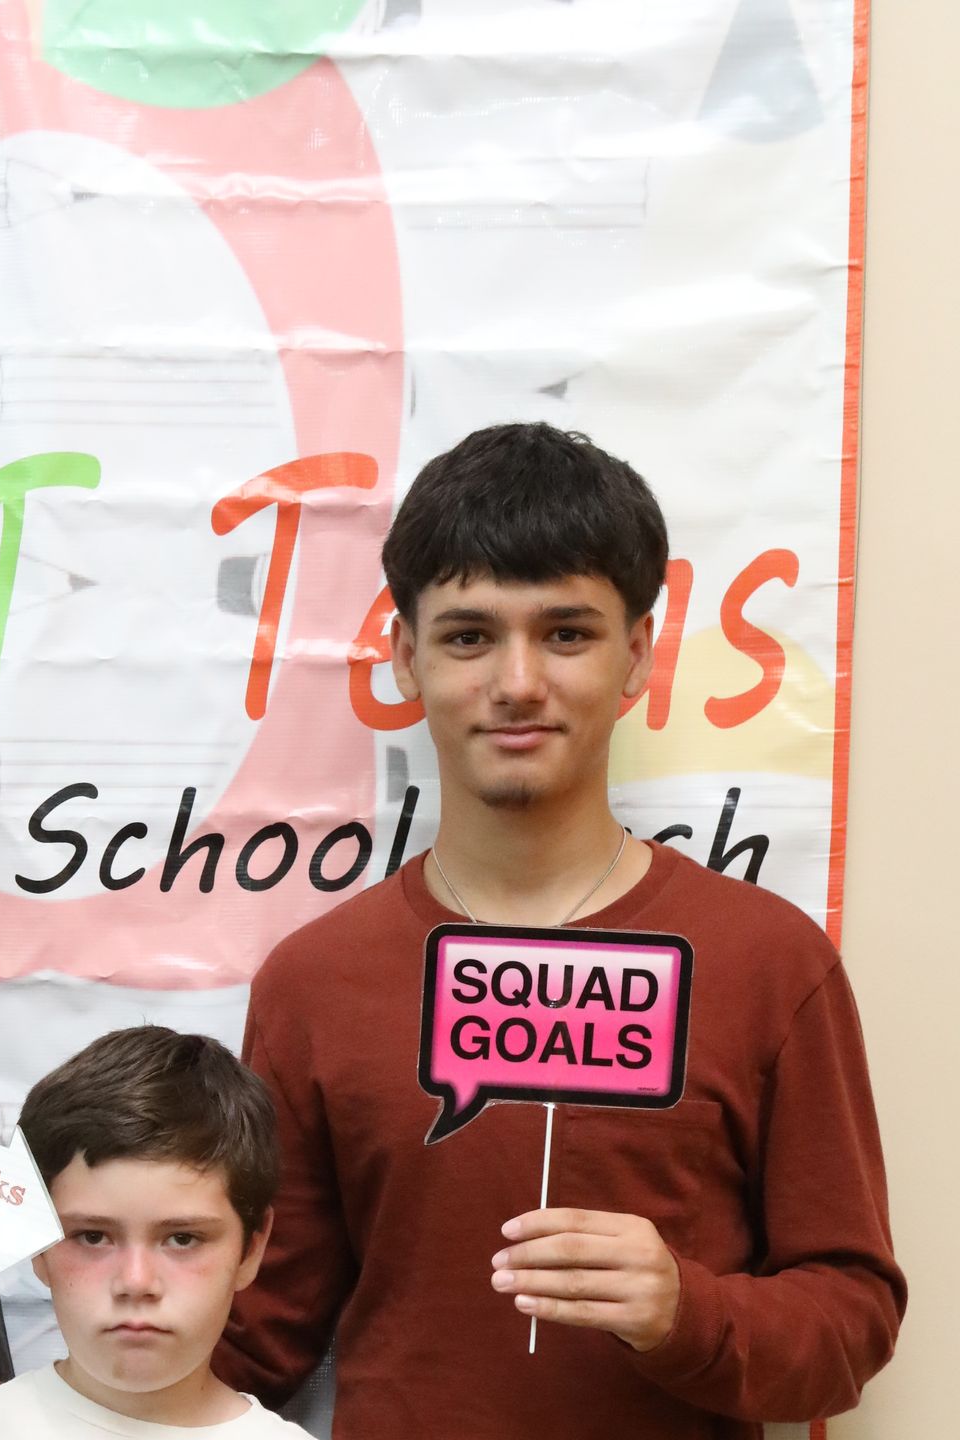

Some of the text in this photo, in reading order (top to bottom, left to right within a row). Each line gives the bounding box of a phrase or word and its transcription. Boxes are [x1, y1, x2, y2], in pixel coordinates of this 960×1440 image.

[15, 782, 420, 894] School
[451, 958, 659, 1012] SQUAD
[450, 1015, 653, 1070] GOALS
